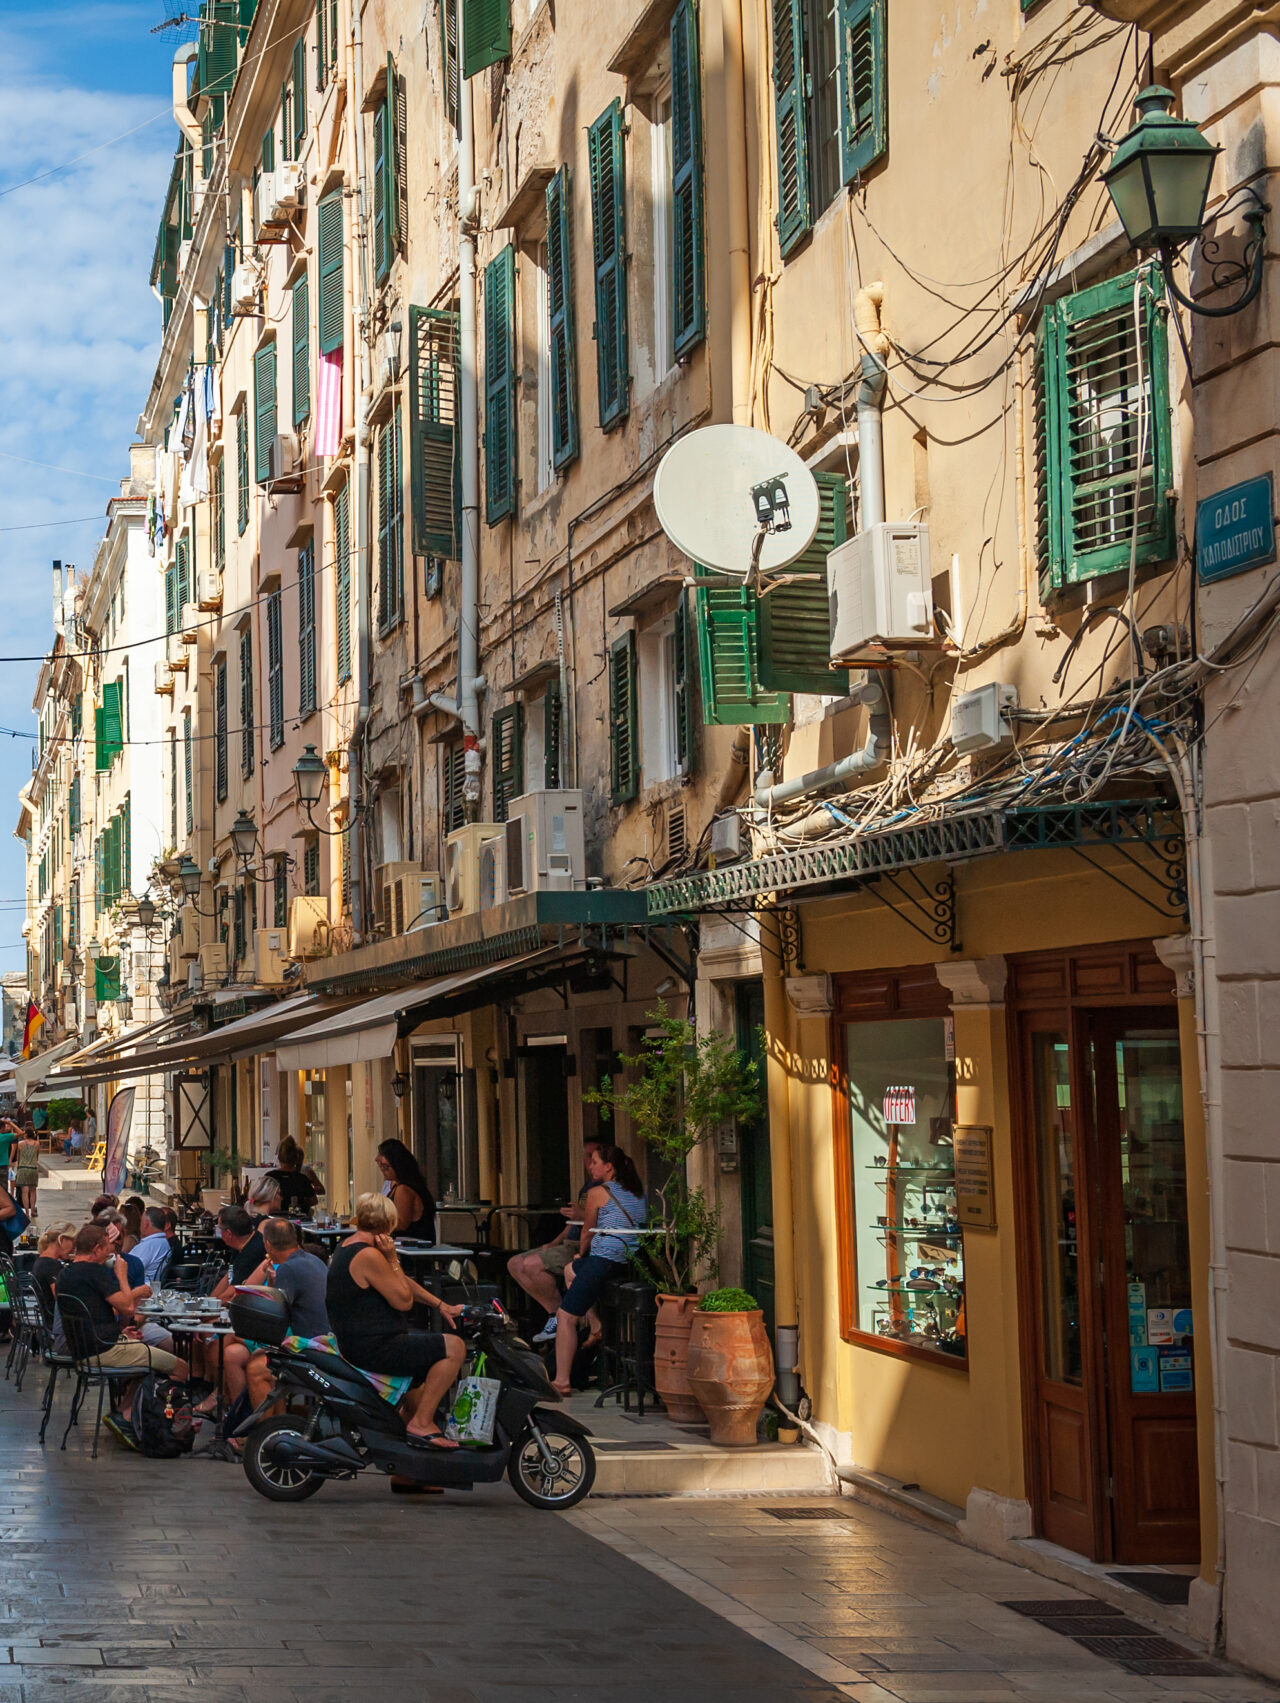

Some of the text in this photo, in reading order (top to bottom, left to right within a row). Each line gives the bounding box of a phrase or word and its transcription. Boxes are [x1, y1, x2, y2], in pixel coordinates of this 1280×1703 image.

[1215, 498, 1247, 529] ΟΔΟΣ
[1203, 526, 1264, 568] ΚΑΠΟΔΙΣΤΡΙΟΥ
[884, 1088, 915, 1122] OFFERS
[308, 1368, 330, 1388] ZERO
